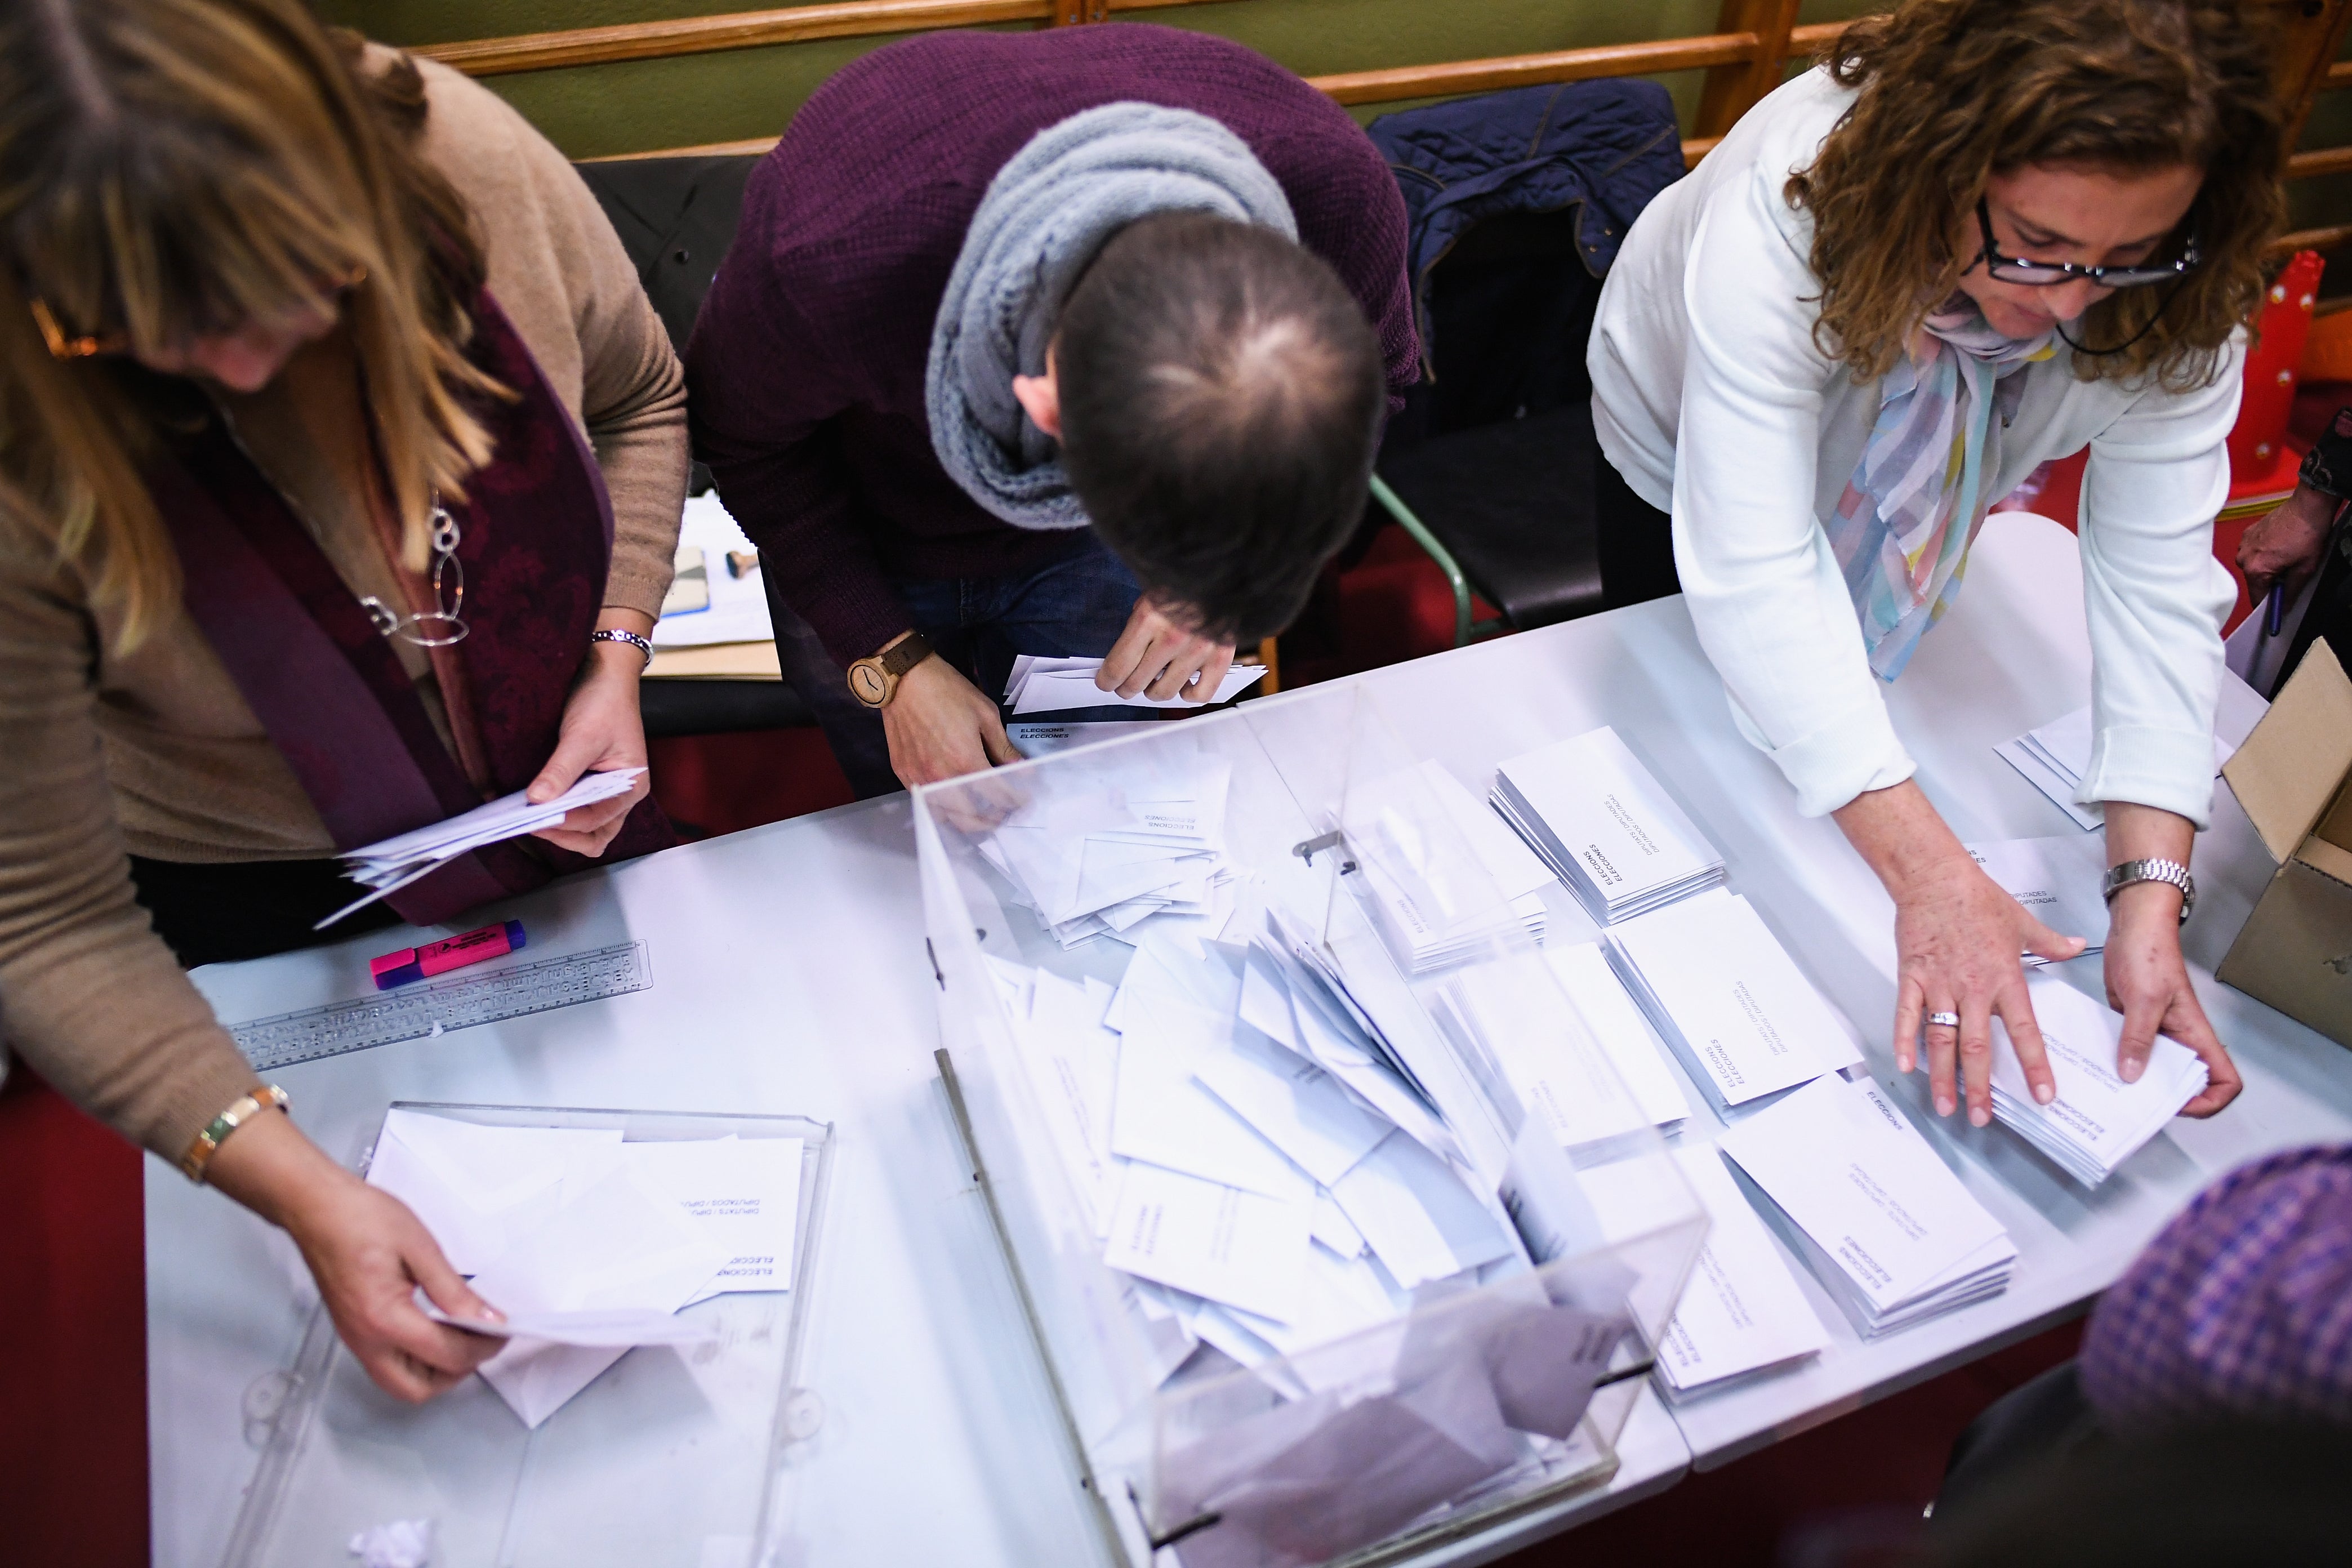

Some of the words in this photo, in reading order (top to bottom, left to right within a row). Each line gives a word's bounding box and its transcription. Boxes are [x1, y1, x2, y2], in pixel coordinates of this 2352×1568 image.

[1604, 801, 1629, 829] DIPUTADES
[1607, 794, 1633, 822] DIPUTADAS
[1630, 831, 1652, 856] DIPUTATS
[1633, 825, 1659, 853] DIPUTADOS
[1583, 851, 1613, 885] ELECCIONS
[1589, 844, 1623, 881] ELECCIONES
[1397, 899, 1424, 933] ELECCIONS
[1732, 989, 1757, 1023] DIPUTADES
[1736, 981, 1762, 1014] DIPUTADAS
[1758, 1027, 1780, 1055] DIPUTATS
[1761, 1018, 1788, 1053] DIPUTADOS
[1705, 1047, 1735, 1088] ELECCIONS
[1711, 1039, 1745, 1084] ELECCIONES
[1867, 1092, 1903, 1131] ELECCIONS
[2048, 1104, 2097, 1141] ELECCIONS
[2053, 1096, 2105, 1133] ELECCIONE
